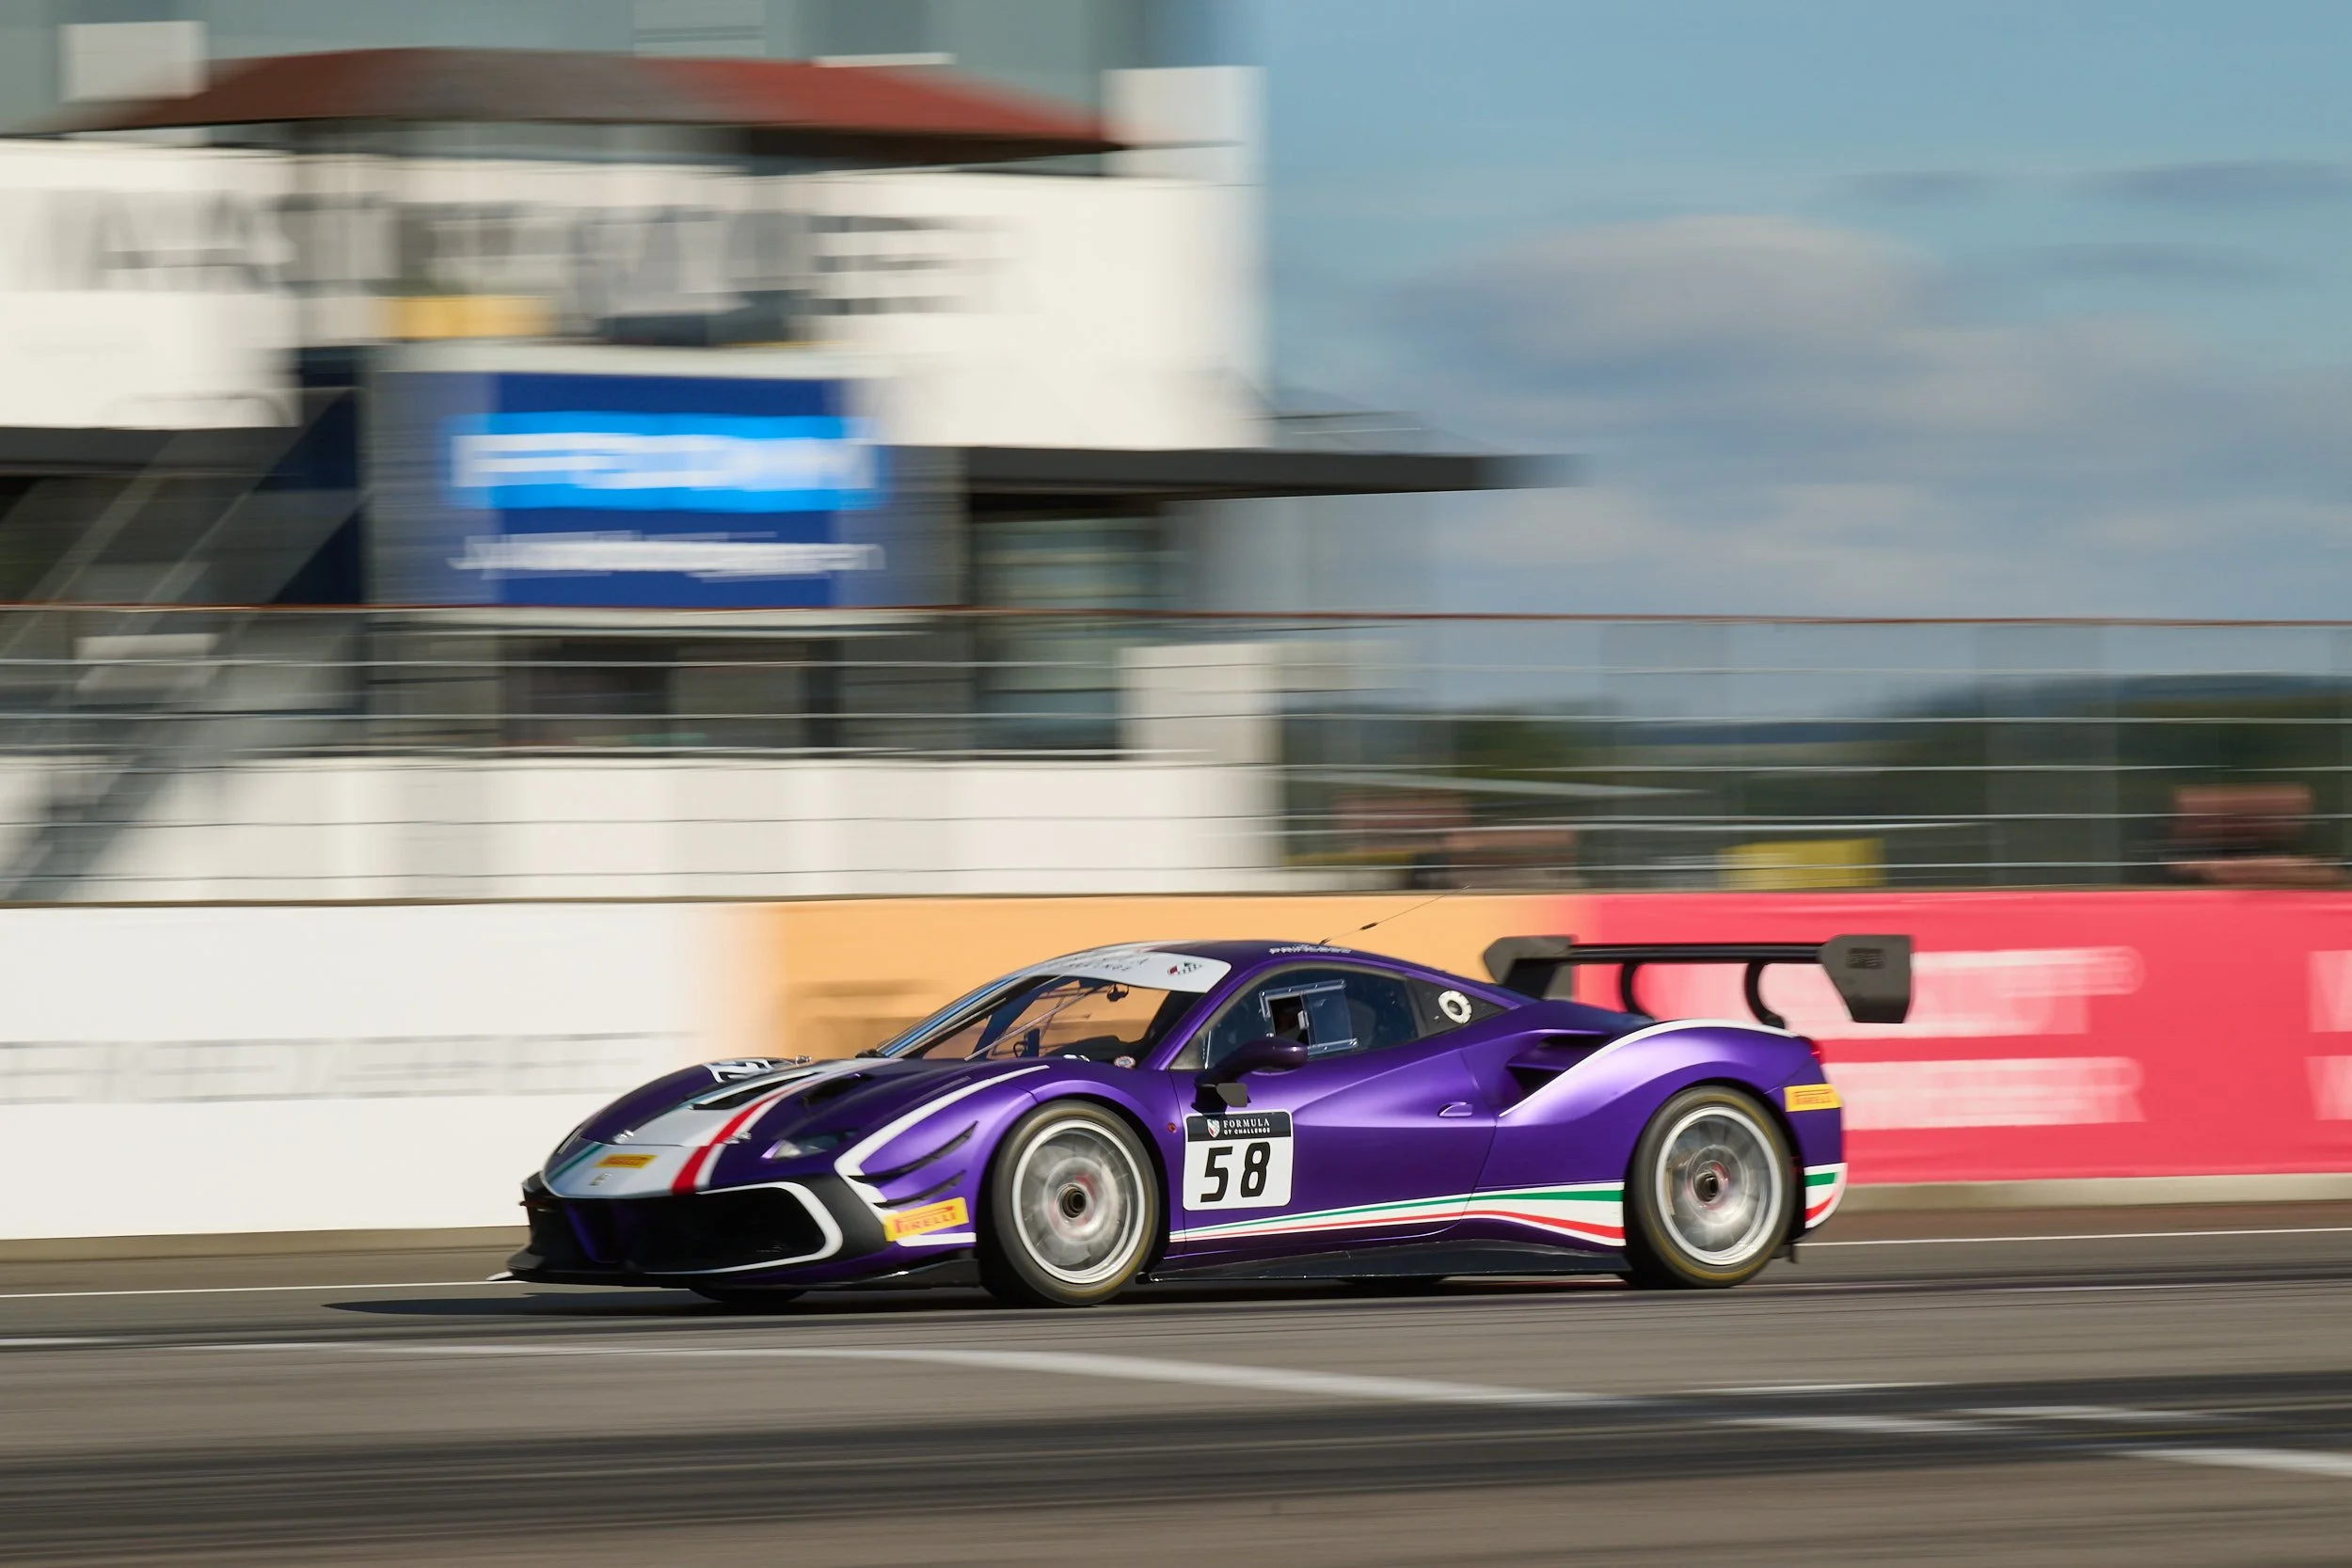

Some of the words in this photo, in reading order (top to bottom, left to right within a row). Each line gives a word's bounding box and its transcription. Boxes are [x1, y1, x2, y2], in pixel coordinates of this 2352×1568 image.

[1223, 1117, 1270, 1129] FORMULA
[1200, 1141, 1271, 1203] 58
[894, 1206, 956, 1234] PIRELLI
